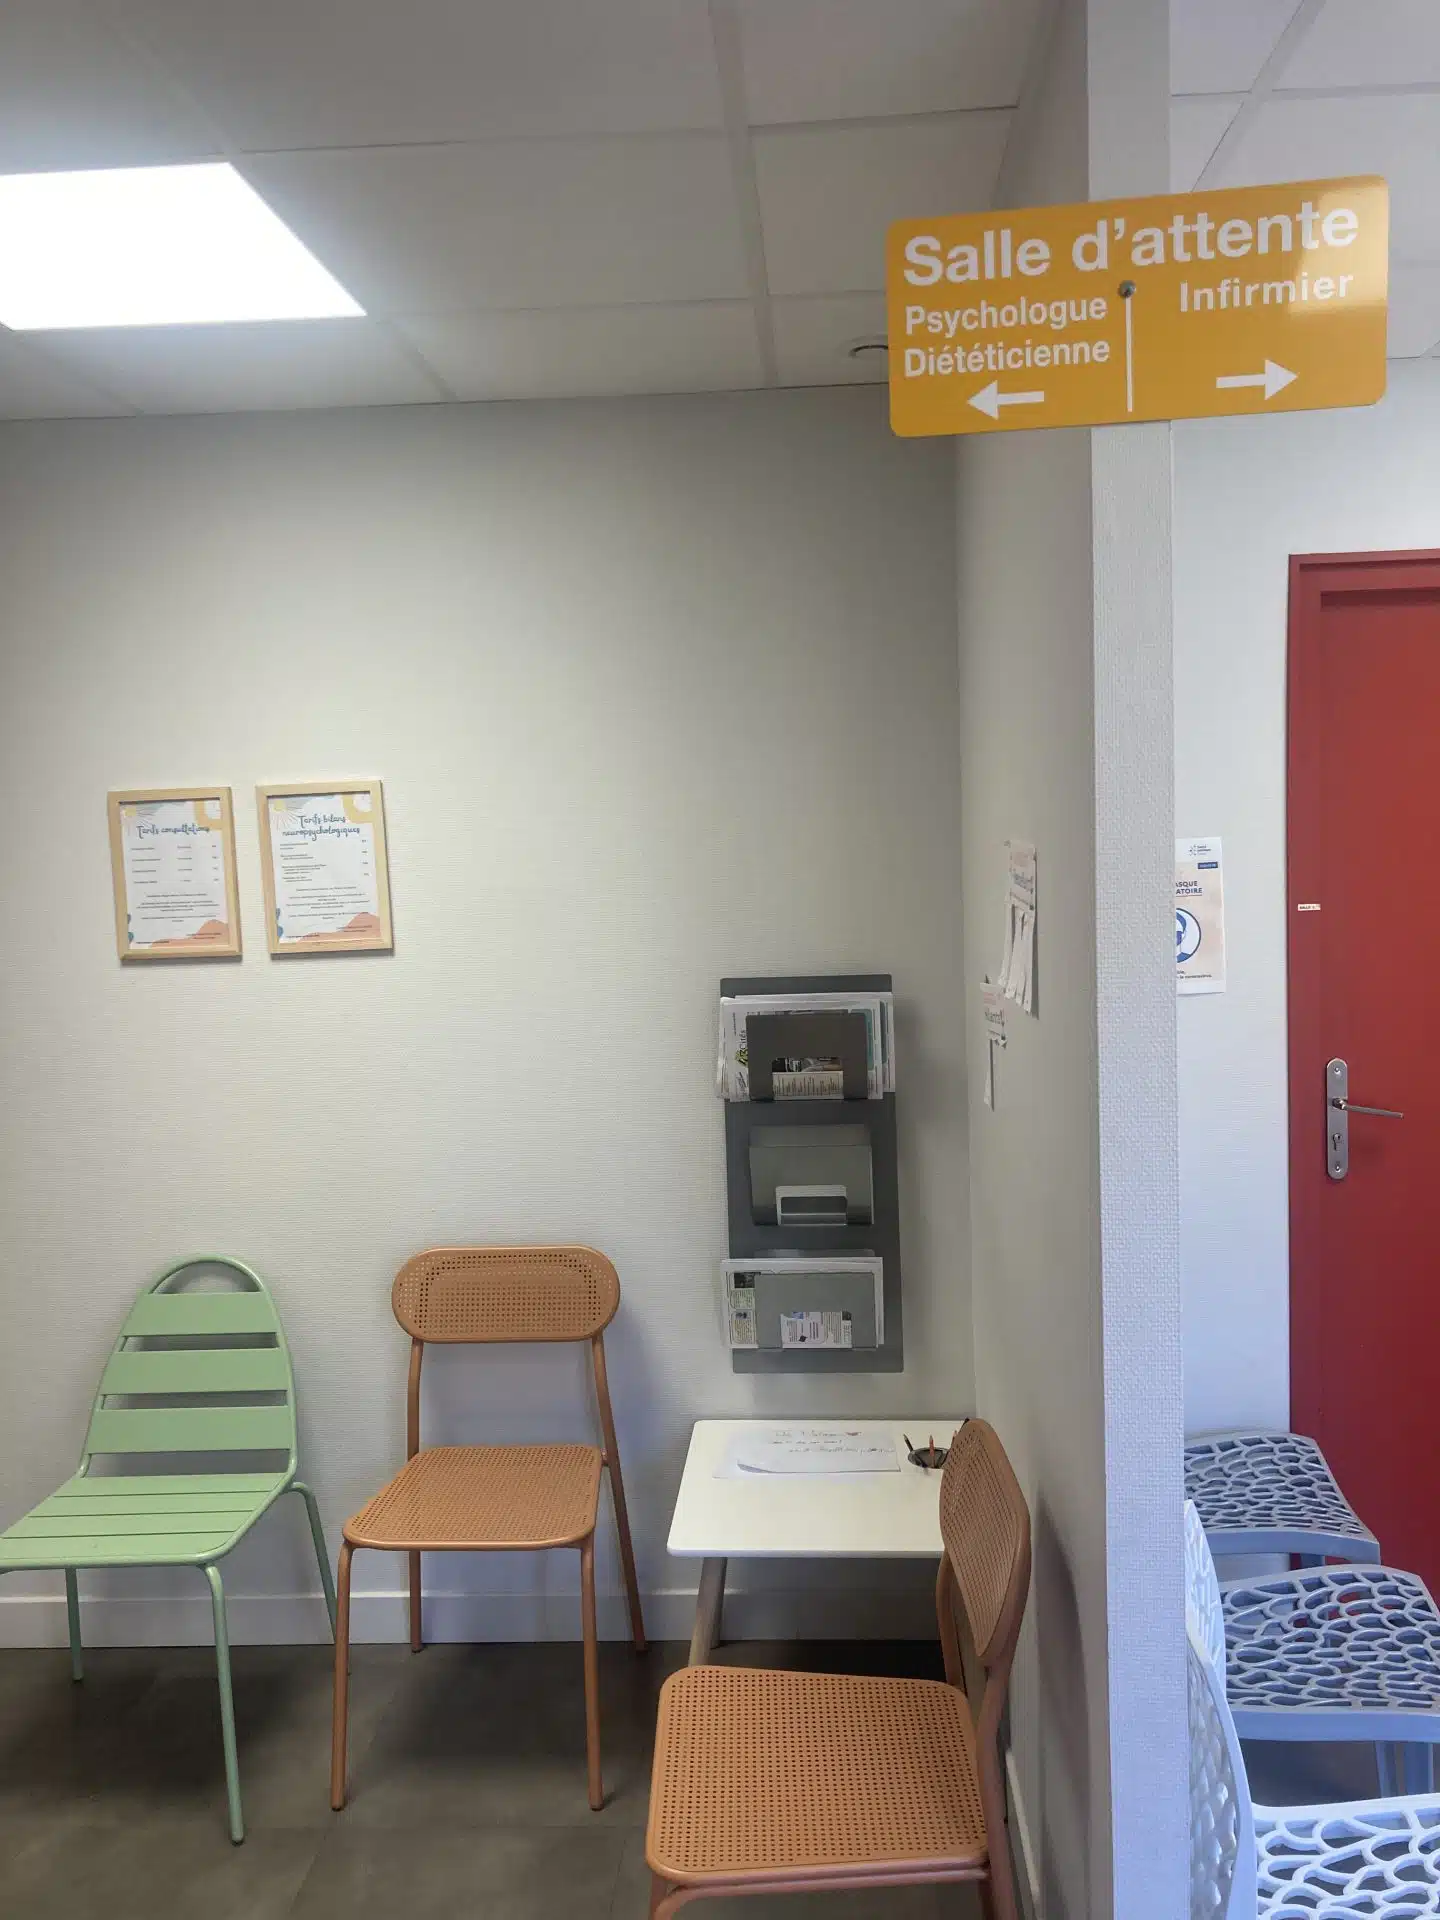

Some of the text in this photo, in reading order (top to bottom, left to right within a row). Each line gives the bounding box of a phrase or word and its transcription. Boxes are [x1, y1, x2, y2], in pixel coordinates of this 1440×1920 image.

[903, 201, 1359, 286] Salle d'attente
[1180, 272, 1354, 312] Infirmier
[905, 296, 1107, 339] Psychologue
[904, 339, 1110, 378] Diététicienne
[136, 824, 160, 839] Tarifs
[282, 826, 360, 841] neuropsychologiques
[298, 814, 346, 828] Tarifs bilans
